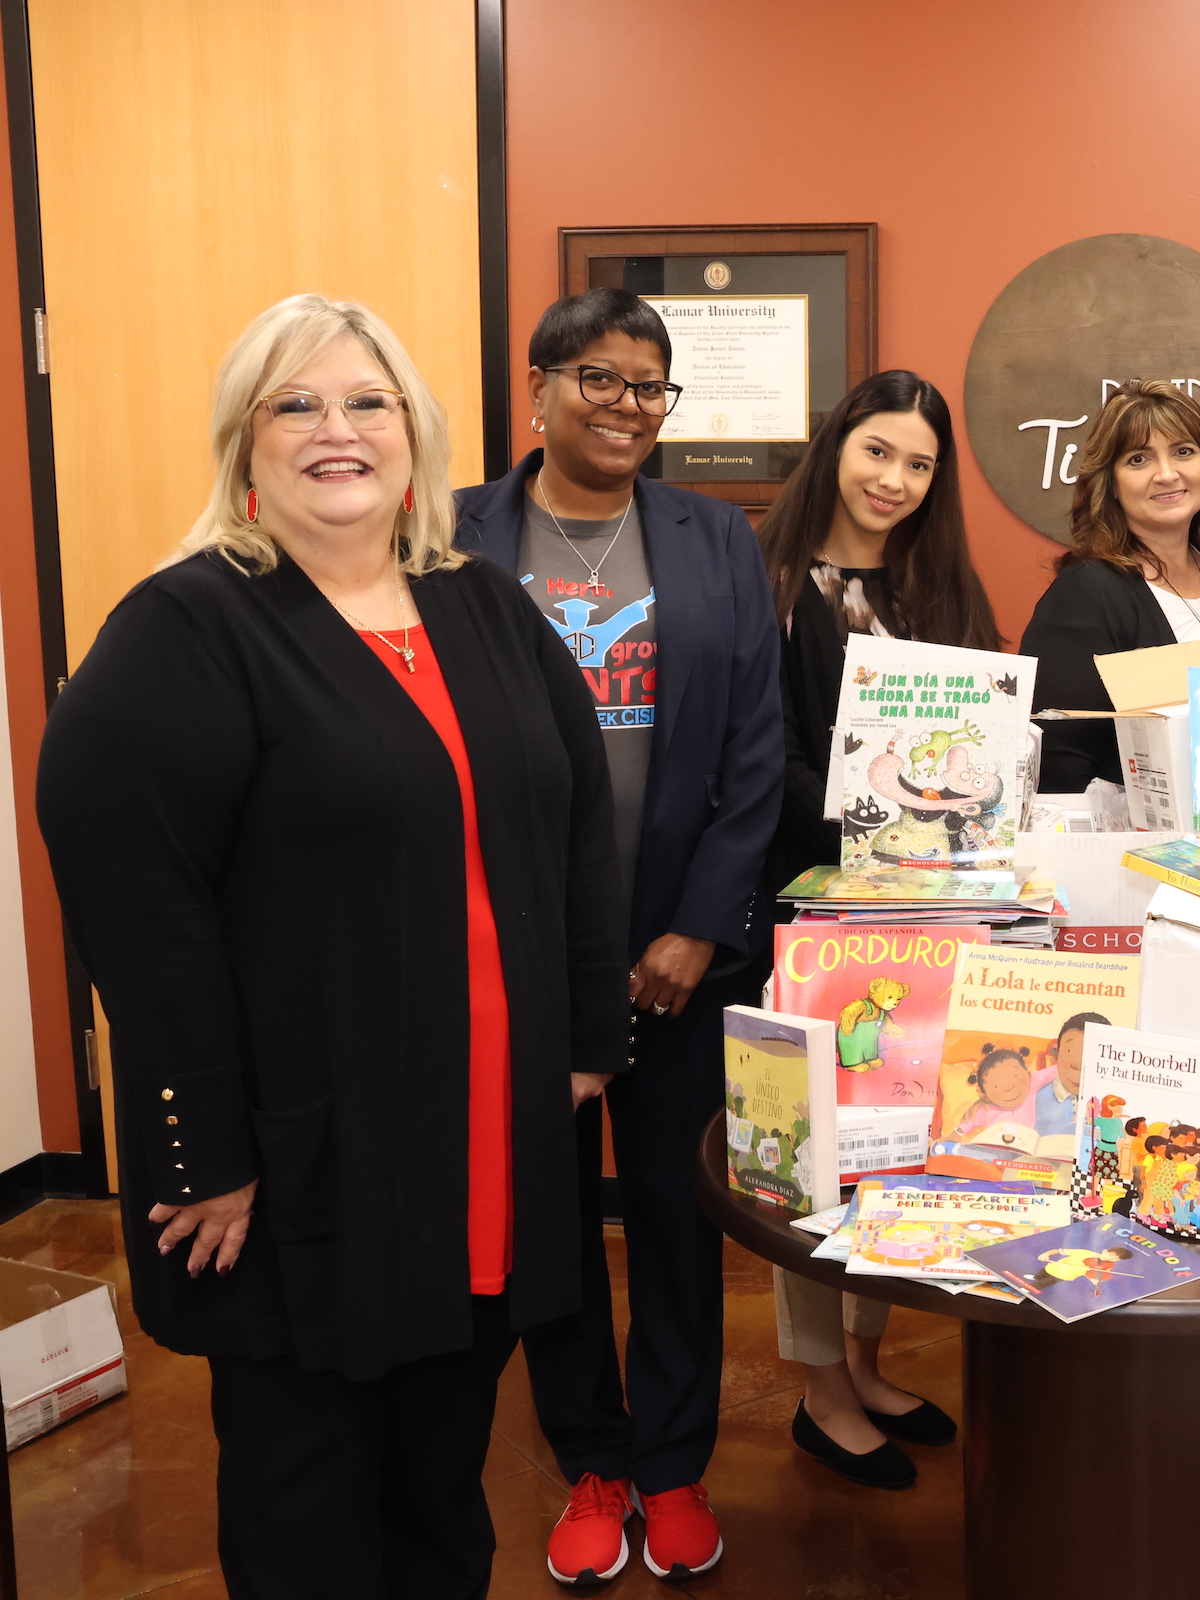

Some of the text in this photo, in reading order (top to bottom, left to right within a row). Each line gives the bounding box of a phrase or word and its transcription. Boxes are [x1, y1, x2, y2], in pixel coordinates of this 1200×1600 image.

[661, 305, 776, 319] Lamar University
[684, 454, 753, 465] Lamar University
[546, 577, 613, 598] Here,
[881, 672, 975, 688] ¡UN DÍA UNA
[860, 687, 991, 704] SEÑORA SE TRAGÓ
[879, 705, 960, 719] UNA RANA!
[838, 926, 923, 935] EDICIÓN ESPAÑOLA
[968, 952, 987, 961] Anna
[988, 954, 1018, 964] McQuinn
[1054, 960, 1067, 969] por
[1067, 960, 1094, 969] Rosalind
[1095, 961, 1129, 971] Beardshaw
[963, 966, 1126, 998] A Lola le encantan
[959, 994, 1054, 1015] los cuentos
[1098, 1043, 1126, 1062] The
[1130, 1049, 1197, 1074] Doorbell
[764, 1068, 771, 1081] EL
[1096, 1062, 1183, 1089] by Pat Hutchins
[755, 1079, 780, 1101] ÚNICO
[752, 1098, 783, 1120] DESTINO
[1002, 1161, 1052, 1172] SCHOLASTIC
[744, 1175, 794, 1198] ALEXANDRA DIAZ
[882, 1192, 1050, 1208] KINDERGARTEN,
[897, 1200, 946, 1209] HERE
[970, 1203, 1028, 1213] COME!
[1101, 1223, 1112, 1232] I
[1114, 1228, 1158, 1249] Can
[1155, 1249, 1180, 1265] Do
[1172, 1266, 1194, 1277] It
[932, 1268, 993, 1276] SCHOLASTI
